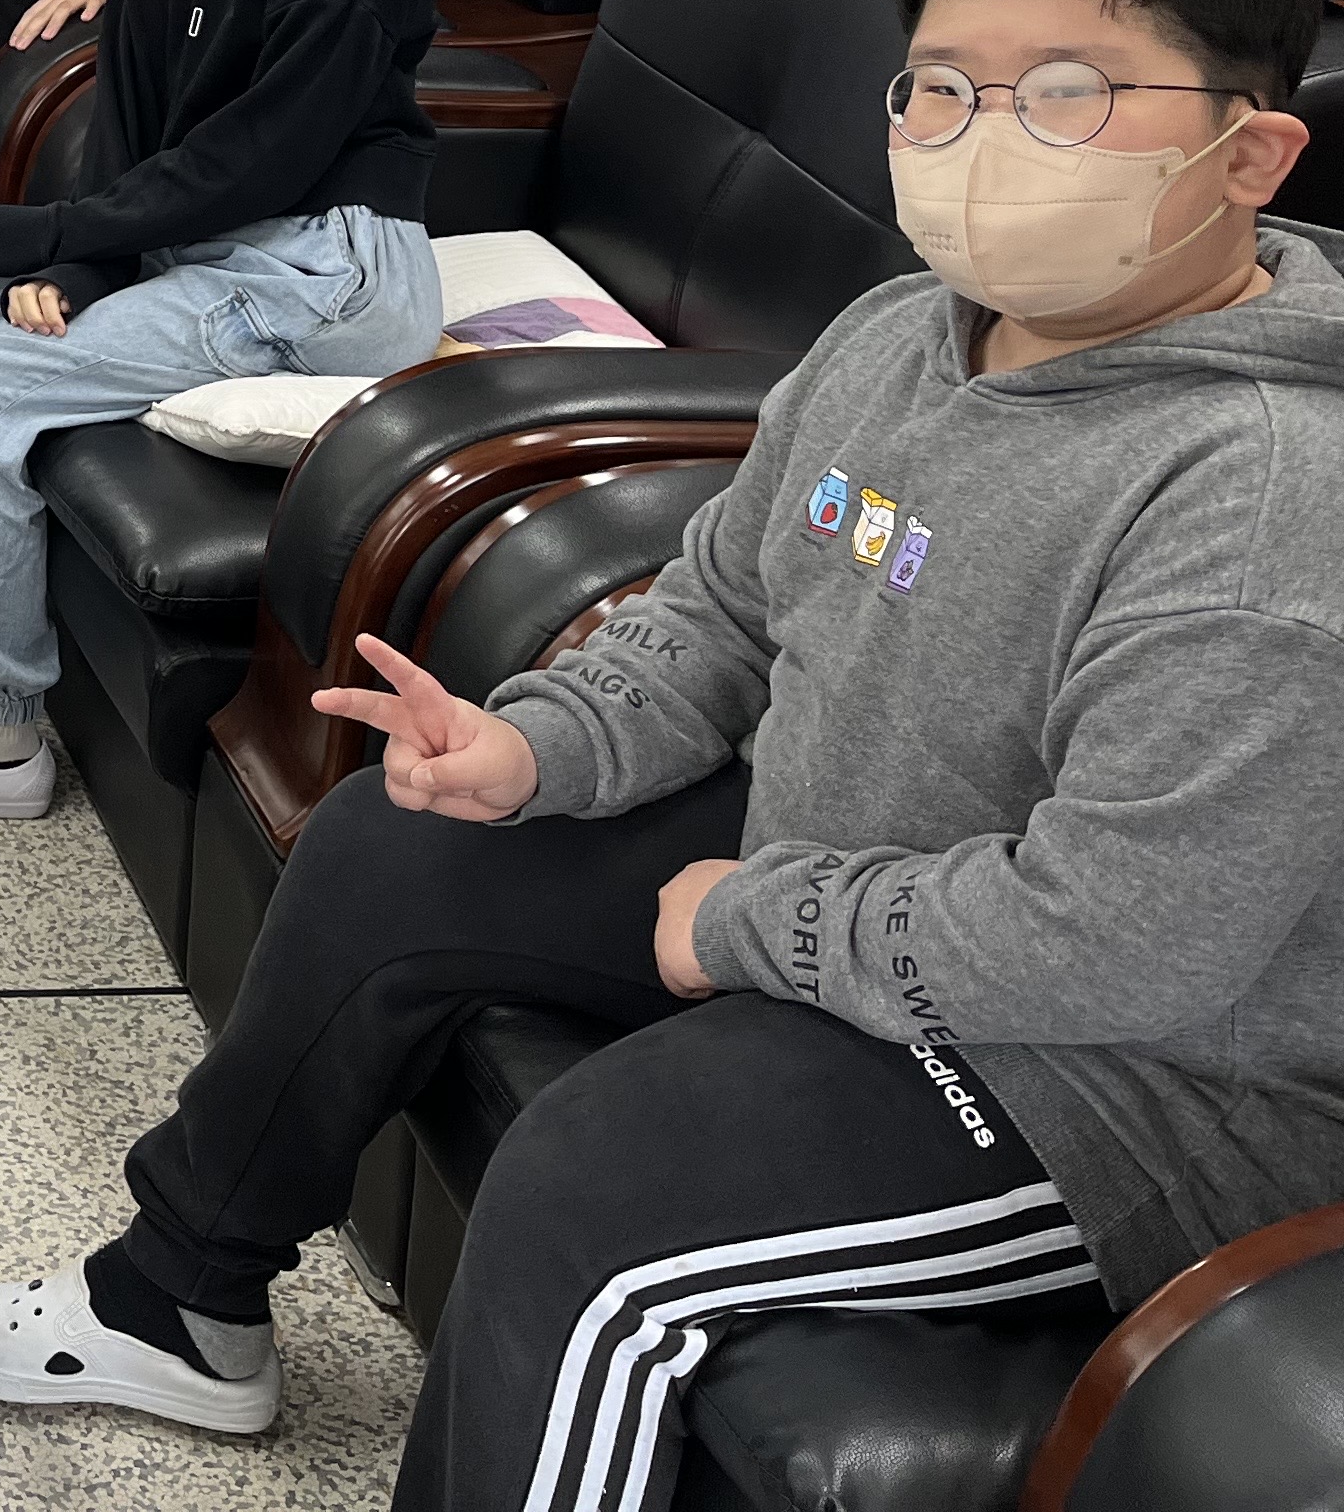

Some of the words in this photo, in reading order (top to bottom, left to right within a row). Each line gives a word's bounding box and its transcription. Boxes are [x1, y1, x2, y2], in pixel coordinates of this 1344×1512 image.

[598, 622, 688, 661] MILK
[792, 853, 844, 1002] AVORIT
[892, 955, 960, 1044] SWE
[909, 1043, 995, 1149] adidas
